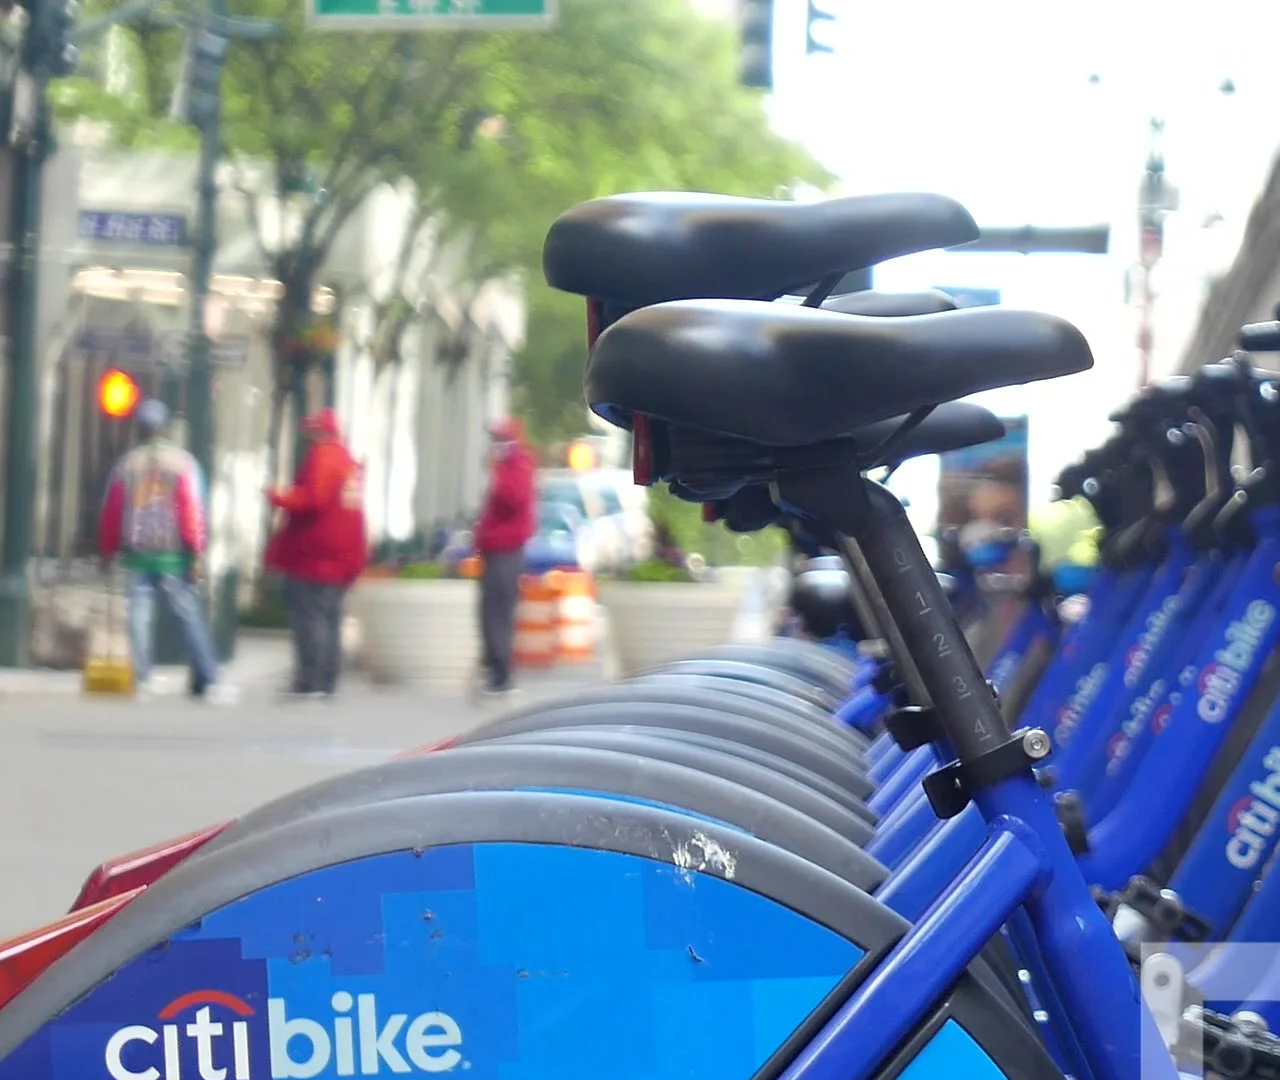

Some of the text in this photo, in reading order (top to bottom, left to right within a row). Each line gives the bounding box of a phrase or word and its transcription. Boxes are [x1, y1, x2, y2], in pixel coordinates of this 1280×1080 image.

[915, 591, 927, 607] 1
[933, 633, 948, 650] 2
[953, 676, 967, 693] 3
[974, 720, 987, 735] 4
